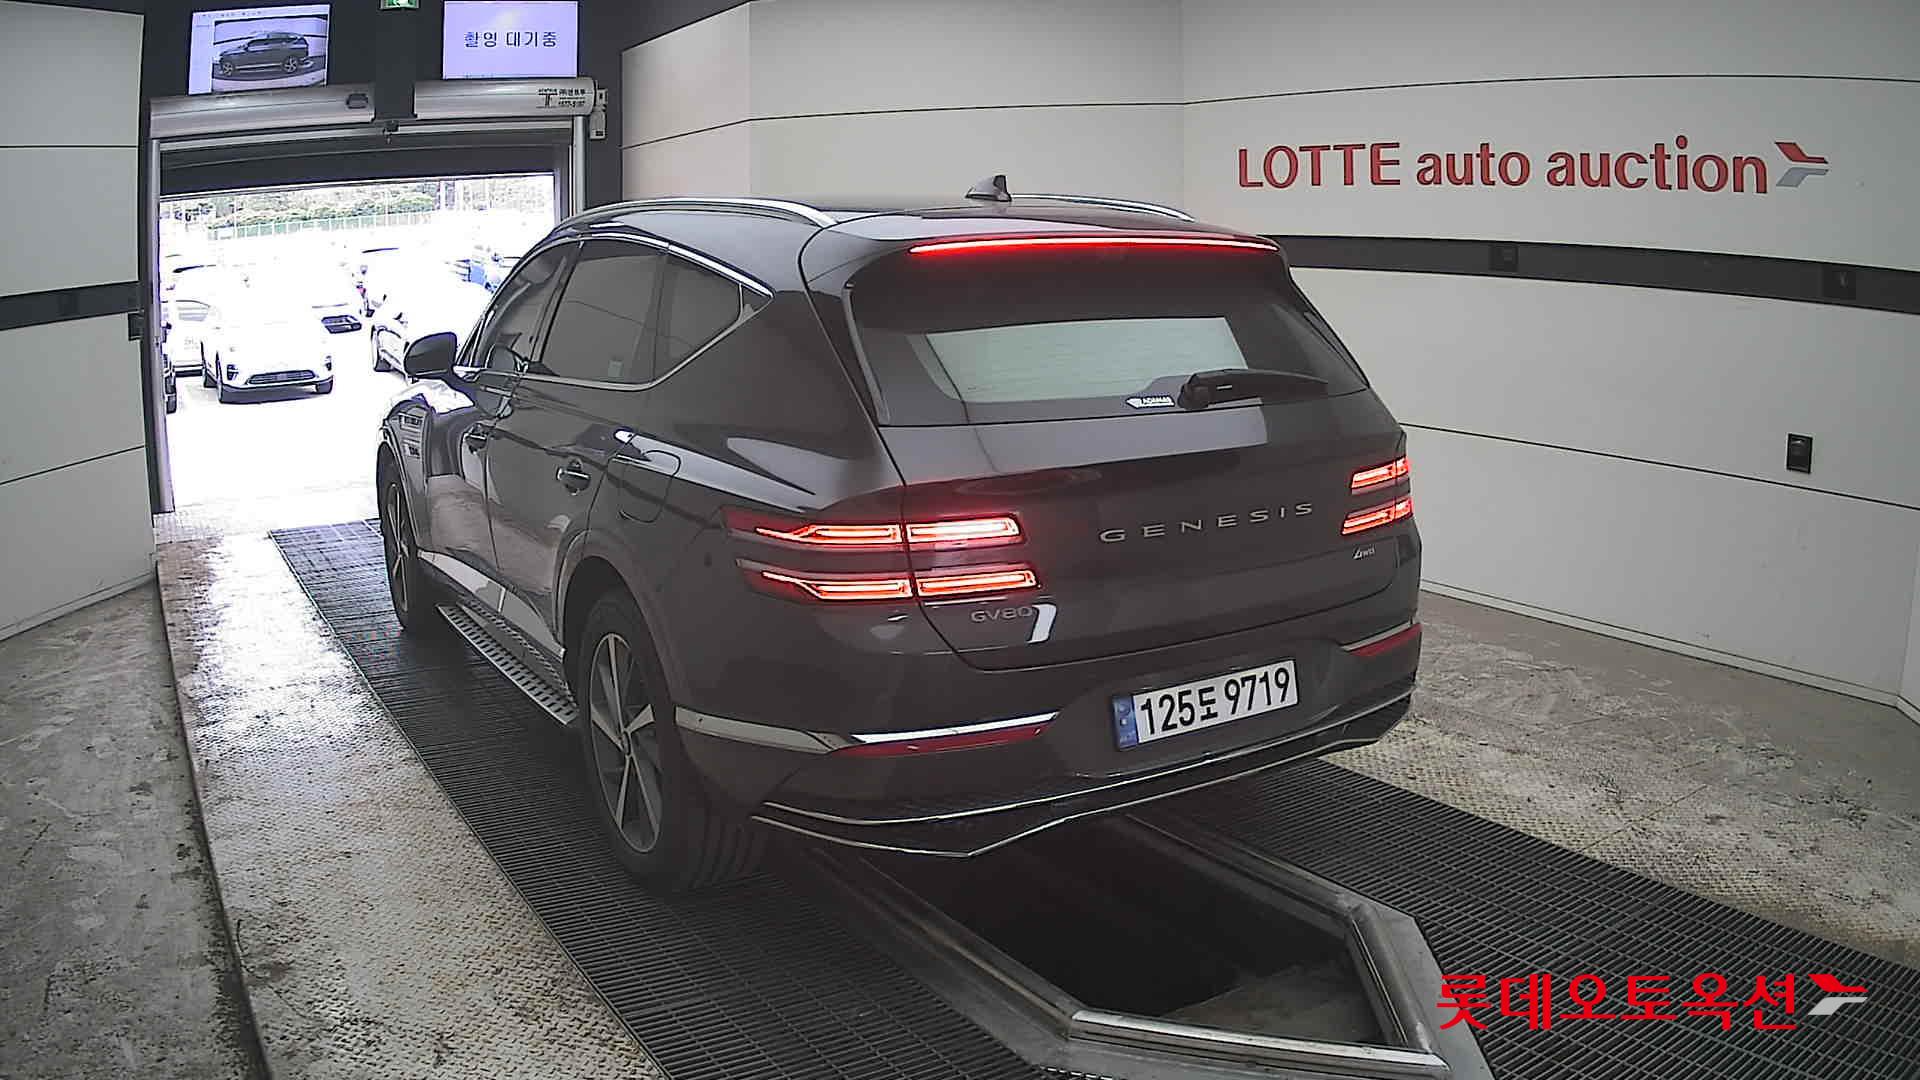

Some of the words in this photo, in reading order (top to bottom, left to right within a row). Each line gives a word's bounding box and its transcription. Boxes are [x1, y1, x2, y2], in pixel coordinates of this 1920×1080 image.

[506, 31, 557, 48] 대기중
[1238, 142, 1400, 189] LOTTE
[1416, 141, 1530, 187] auto
[1547, 135, 1768, 194] auction
[1099, 502, 1314, 543] GENESIS
[970, 606, 1034, 623] GV80
[1140, 685, 1219, 735] 125도
[1223, 667, 1291, 715] 9719
